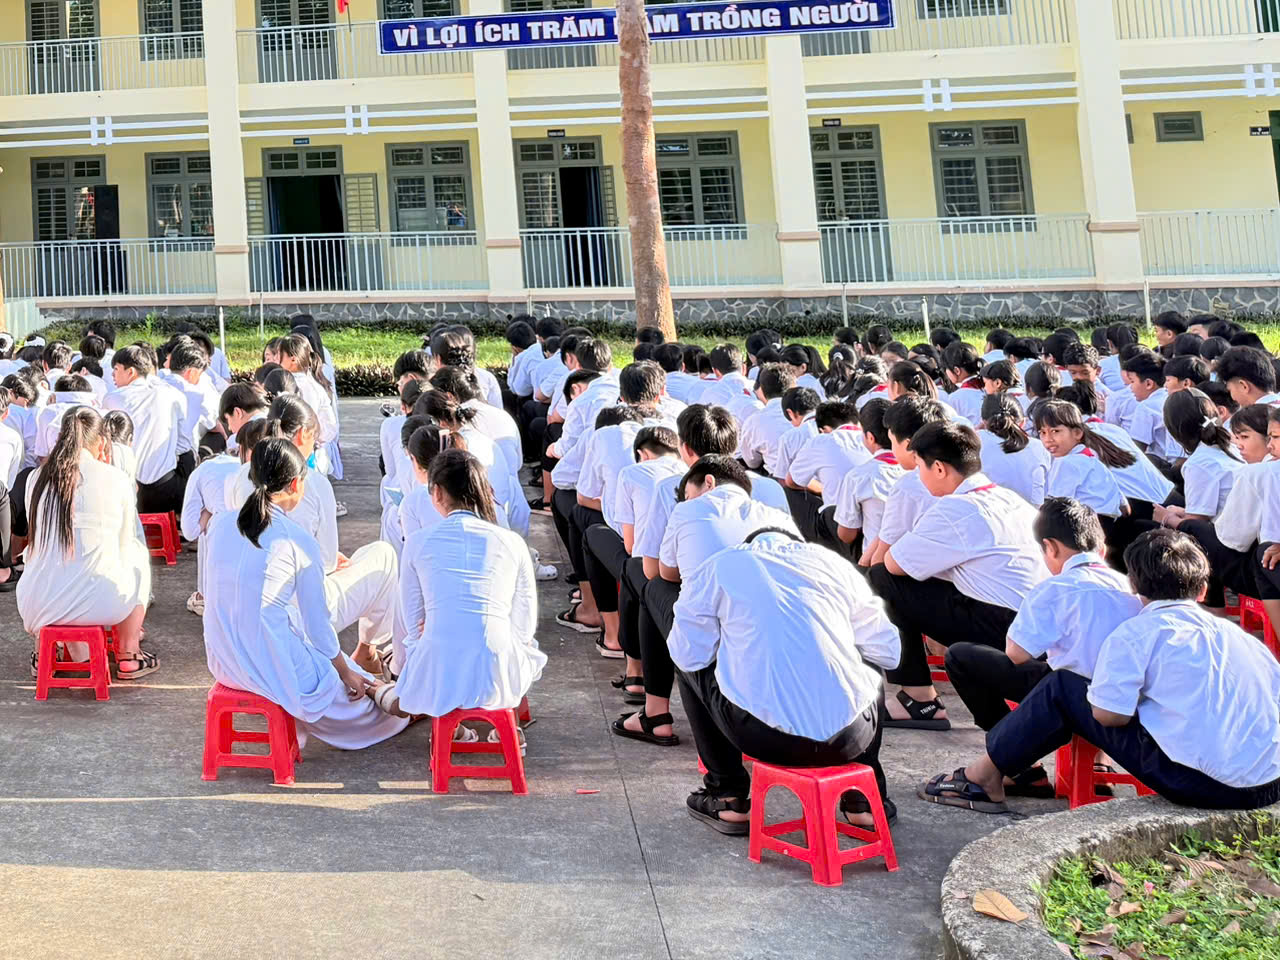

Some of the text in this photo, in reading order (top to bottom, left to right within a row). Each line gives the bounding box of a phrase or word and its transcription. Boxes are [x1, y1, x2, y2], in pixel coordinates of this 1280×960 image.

[687, 4, 781, 31] TRỒNG
[789, 0, 879, 26] NGƯỜI
[393, 24, 418, 47] VÌ
[426, 24, 467, 48] LỢI
[475, 20, 520, 43] ÍCH
[527, 17, 605, 40] TRĂM
